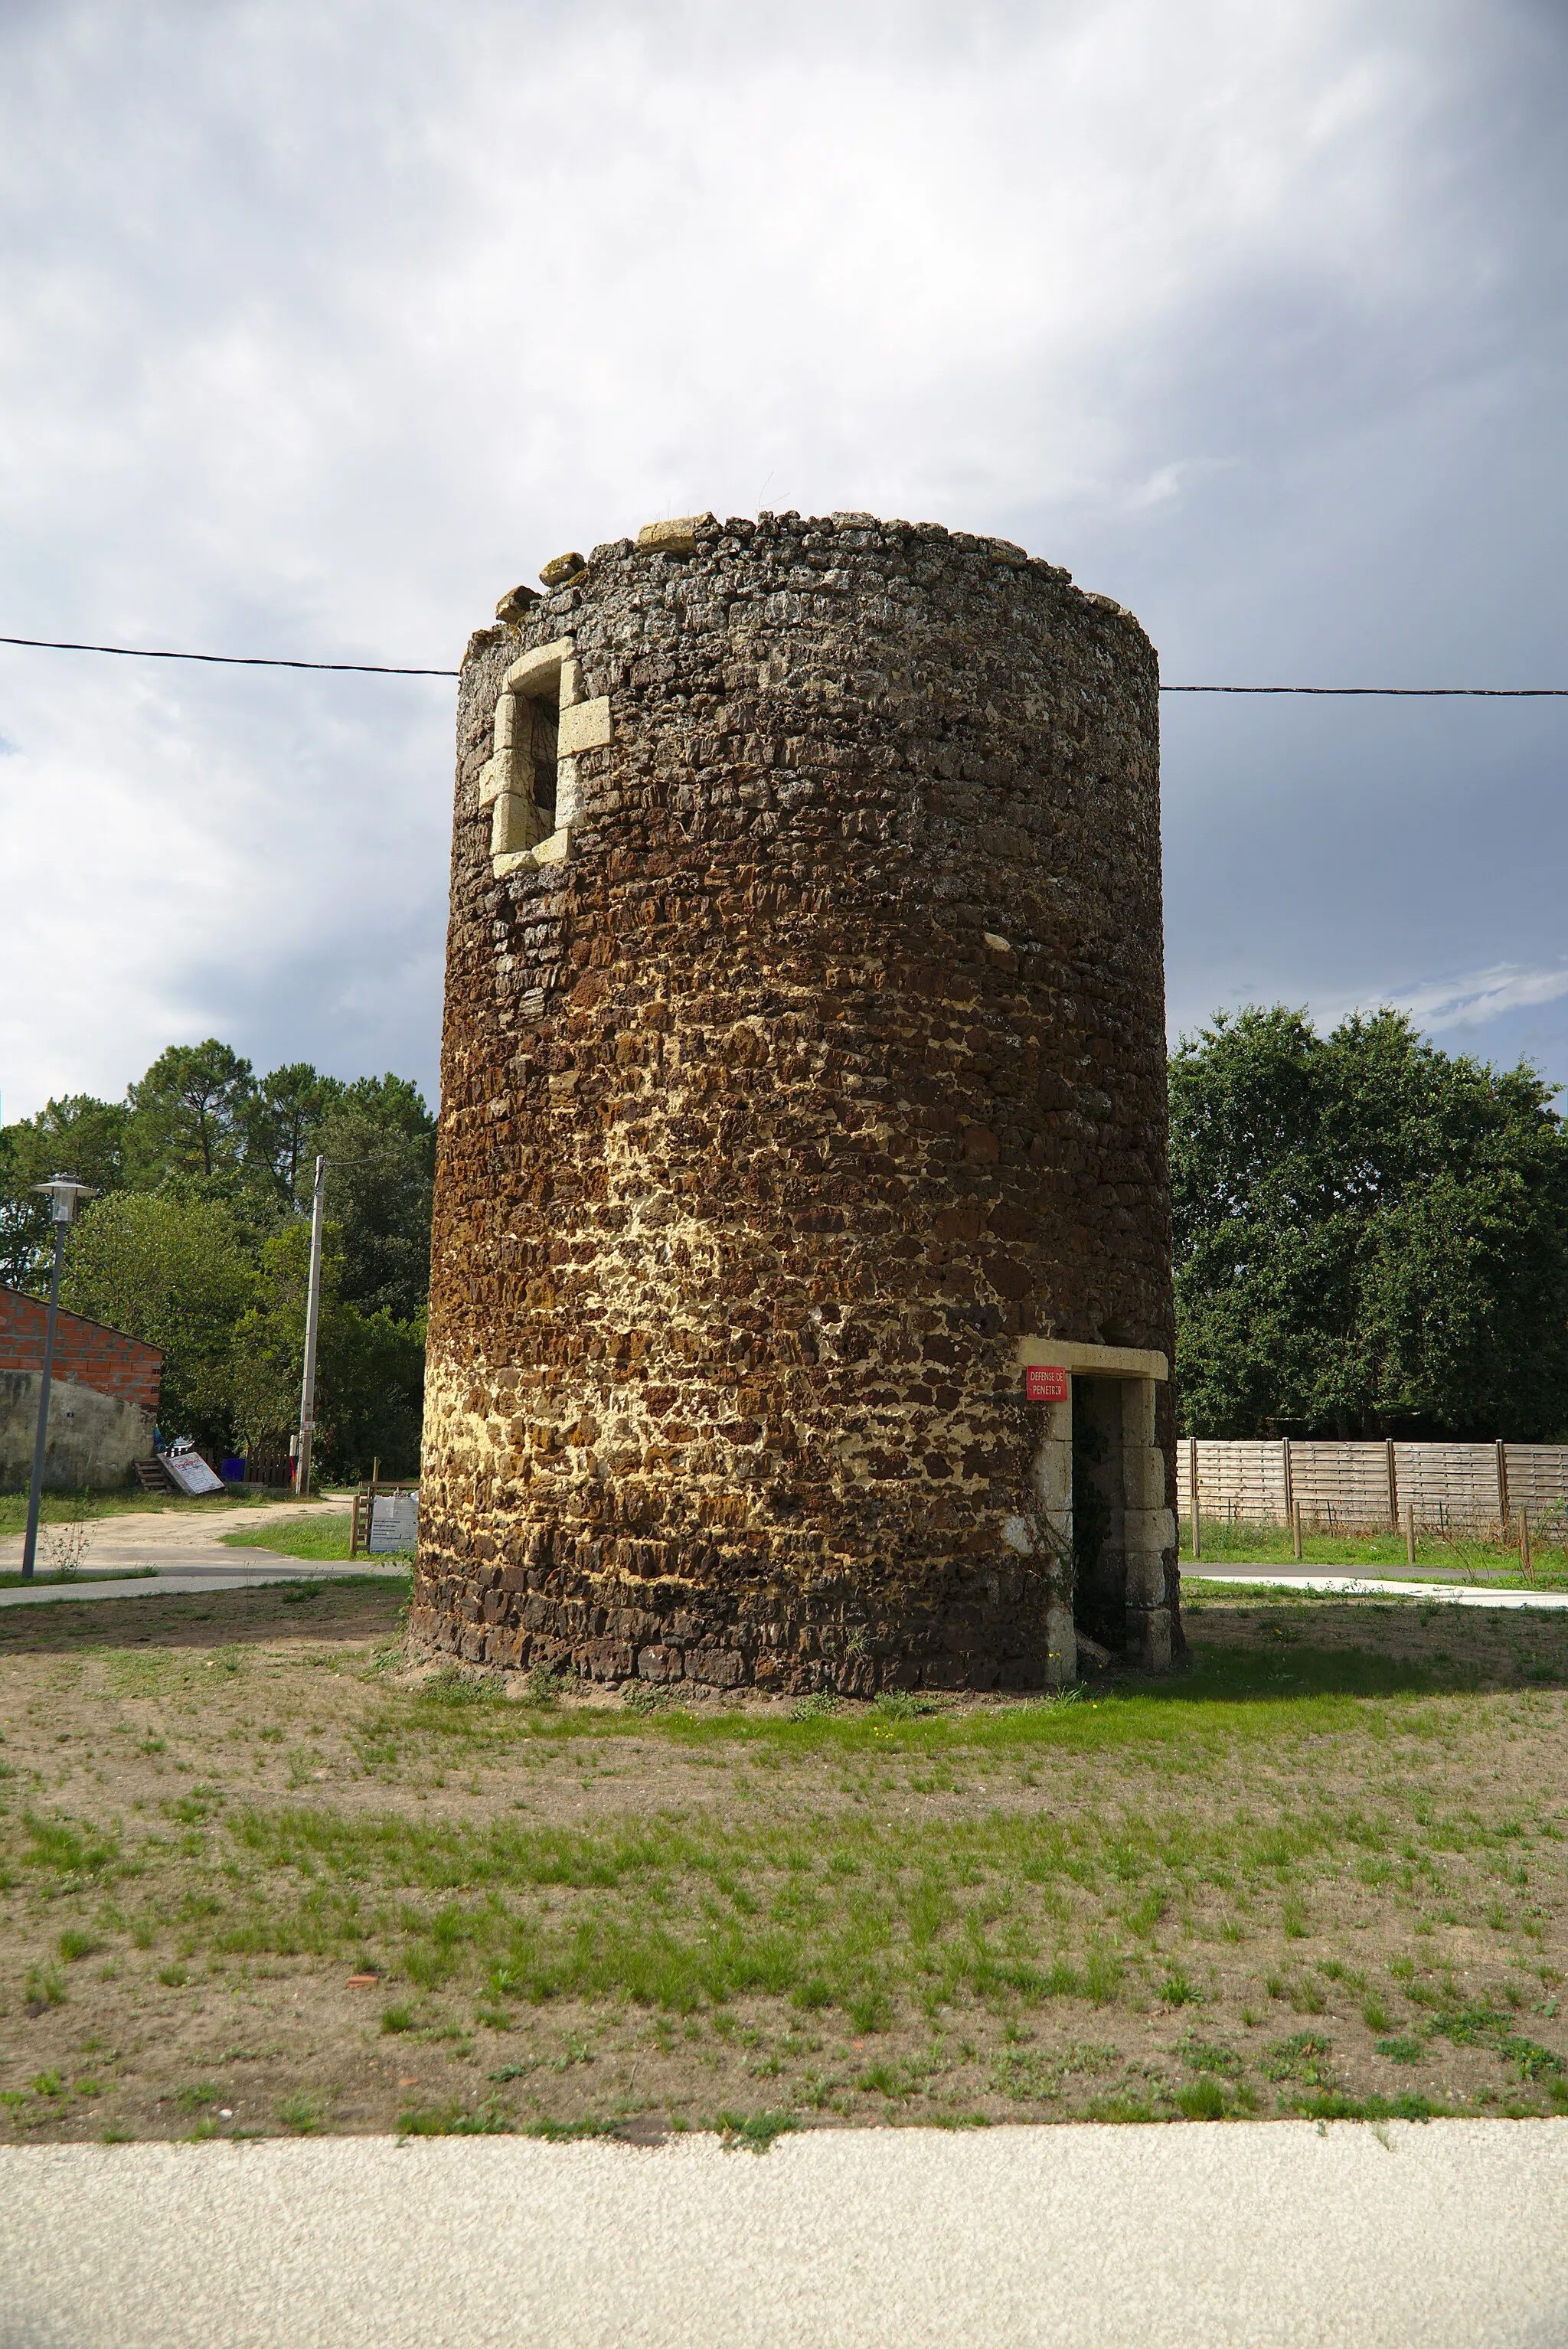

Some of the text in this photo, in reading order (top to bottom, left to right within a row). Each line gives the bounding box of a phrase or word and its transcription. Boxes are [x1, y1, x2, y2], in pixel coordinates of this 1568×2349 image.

[1031, 1371, 1063, 1381] DEFENSE DE
[1033, 1385, 1061, 1394] PENETRER
